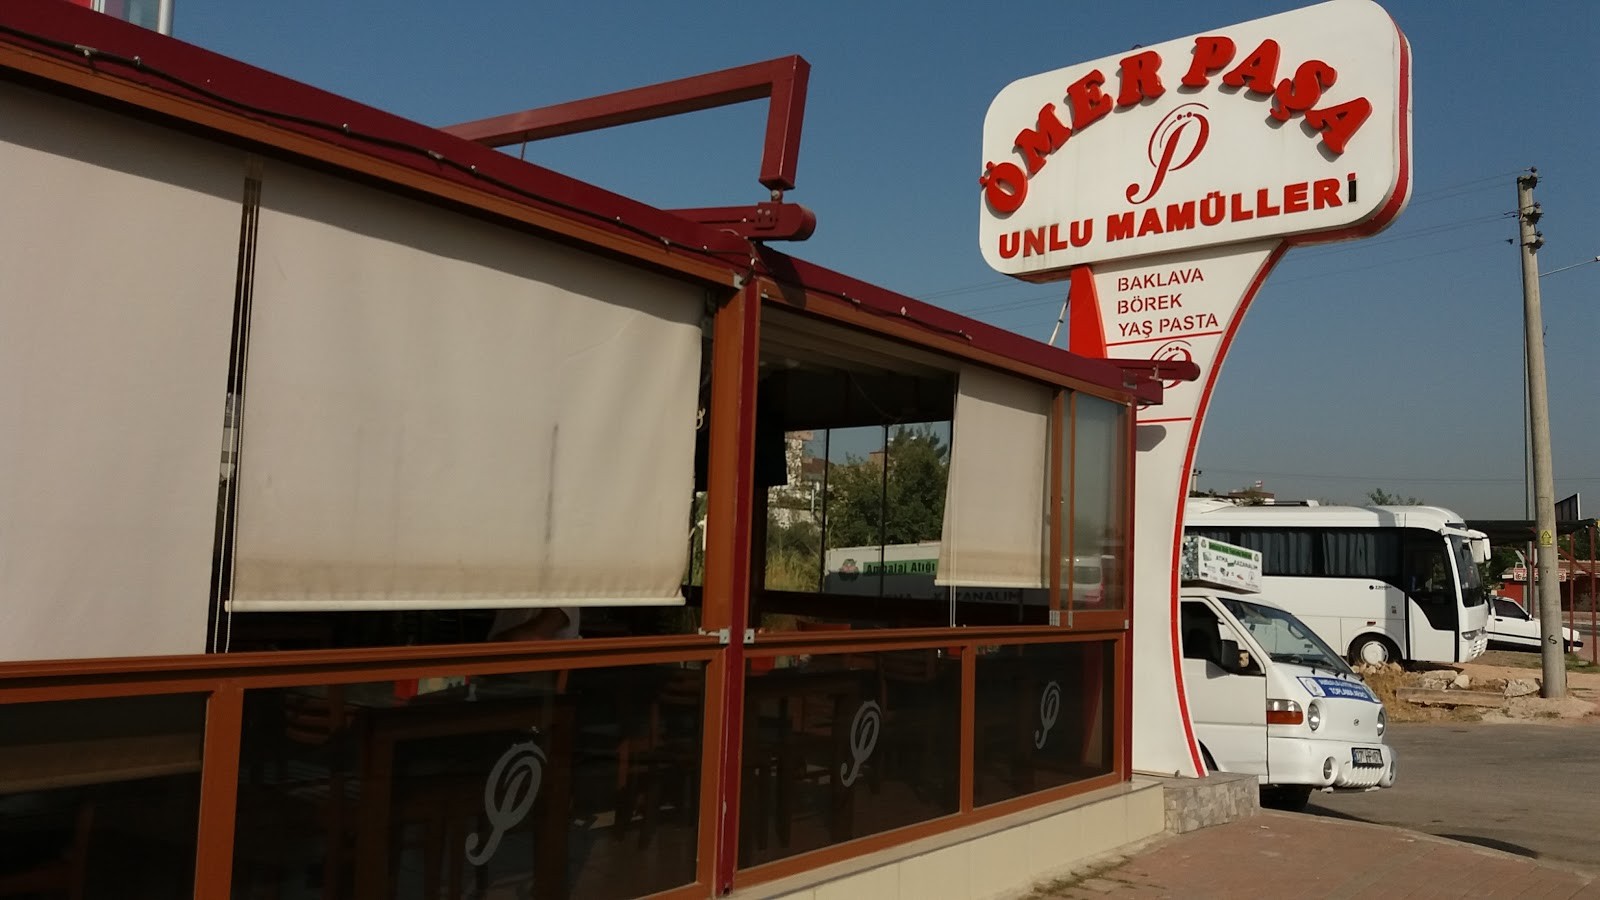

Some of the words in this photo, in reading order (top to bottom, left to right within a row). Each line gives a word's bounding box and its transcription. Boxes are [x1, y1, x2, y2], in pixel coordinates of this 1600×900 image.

[979, 50, 1166, 213] ÖMER
[1180, 36, 1373, 154] PAŞA
[1000, 219, 1093, 259] UNLU
[1106, 173, 1357, 242] MAMÜLLERİ
[1117, 268, 1204, 292] BAKLAVA
[1117, 293, 1183, 315] BÖREK
[1118, 320, 1153, 338] YAŞ
[1159, 313, 1219, 333] PASTA
